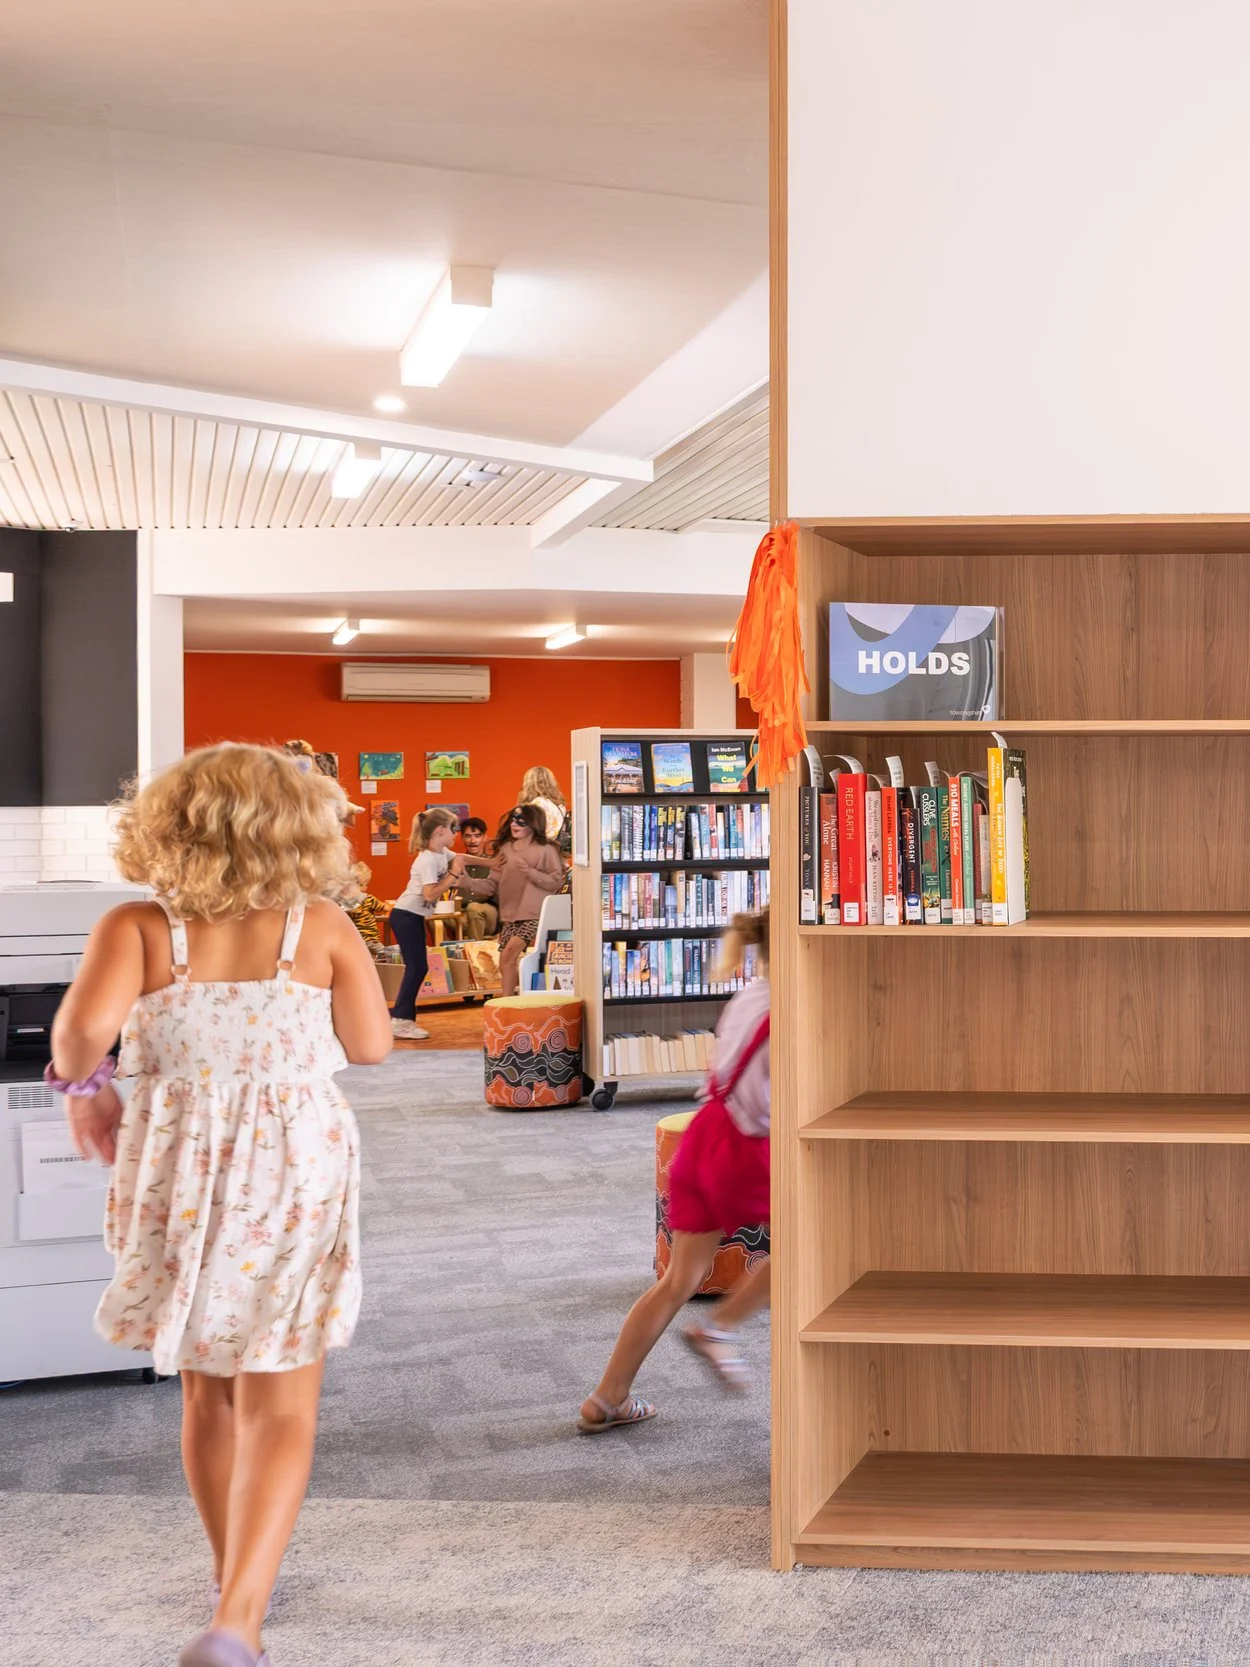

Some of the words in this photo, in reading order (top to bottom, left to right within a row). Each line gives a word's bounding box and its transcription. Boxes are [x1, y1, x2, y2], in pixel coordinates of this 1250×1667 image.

[858, 650, 970, 676] HOLDS
[721, 764, 734, 772] We
[845, 787, 854, 806] RED
[846, 809, 854, 840] EARTH
[941, 806, 950, 840] Names
[950, 798, 959, 827] MEALS
[822, 820, 830, 844] Alone
